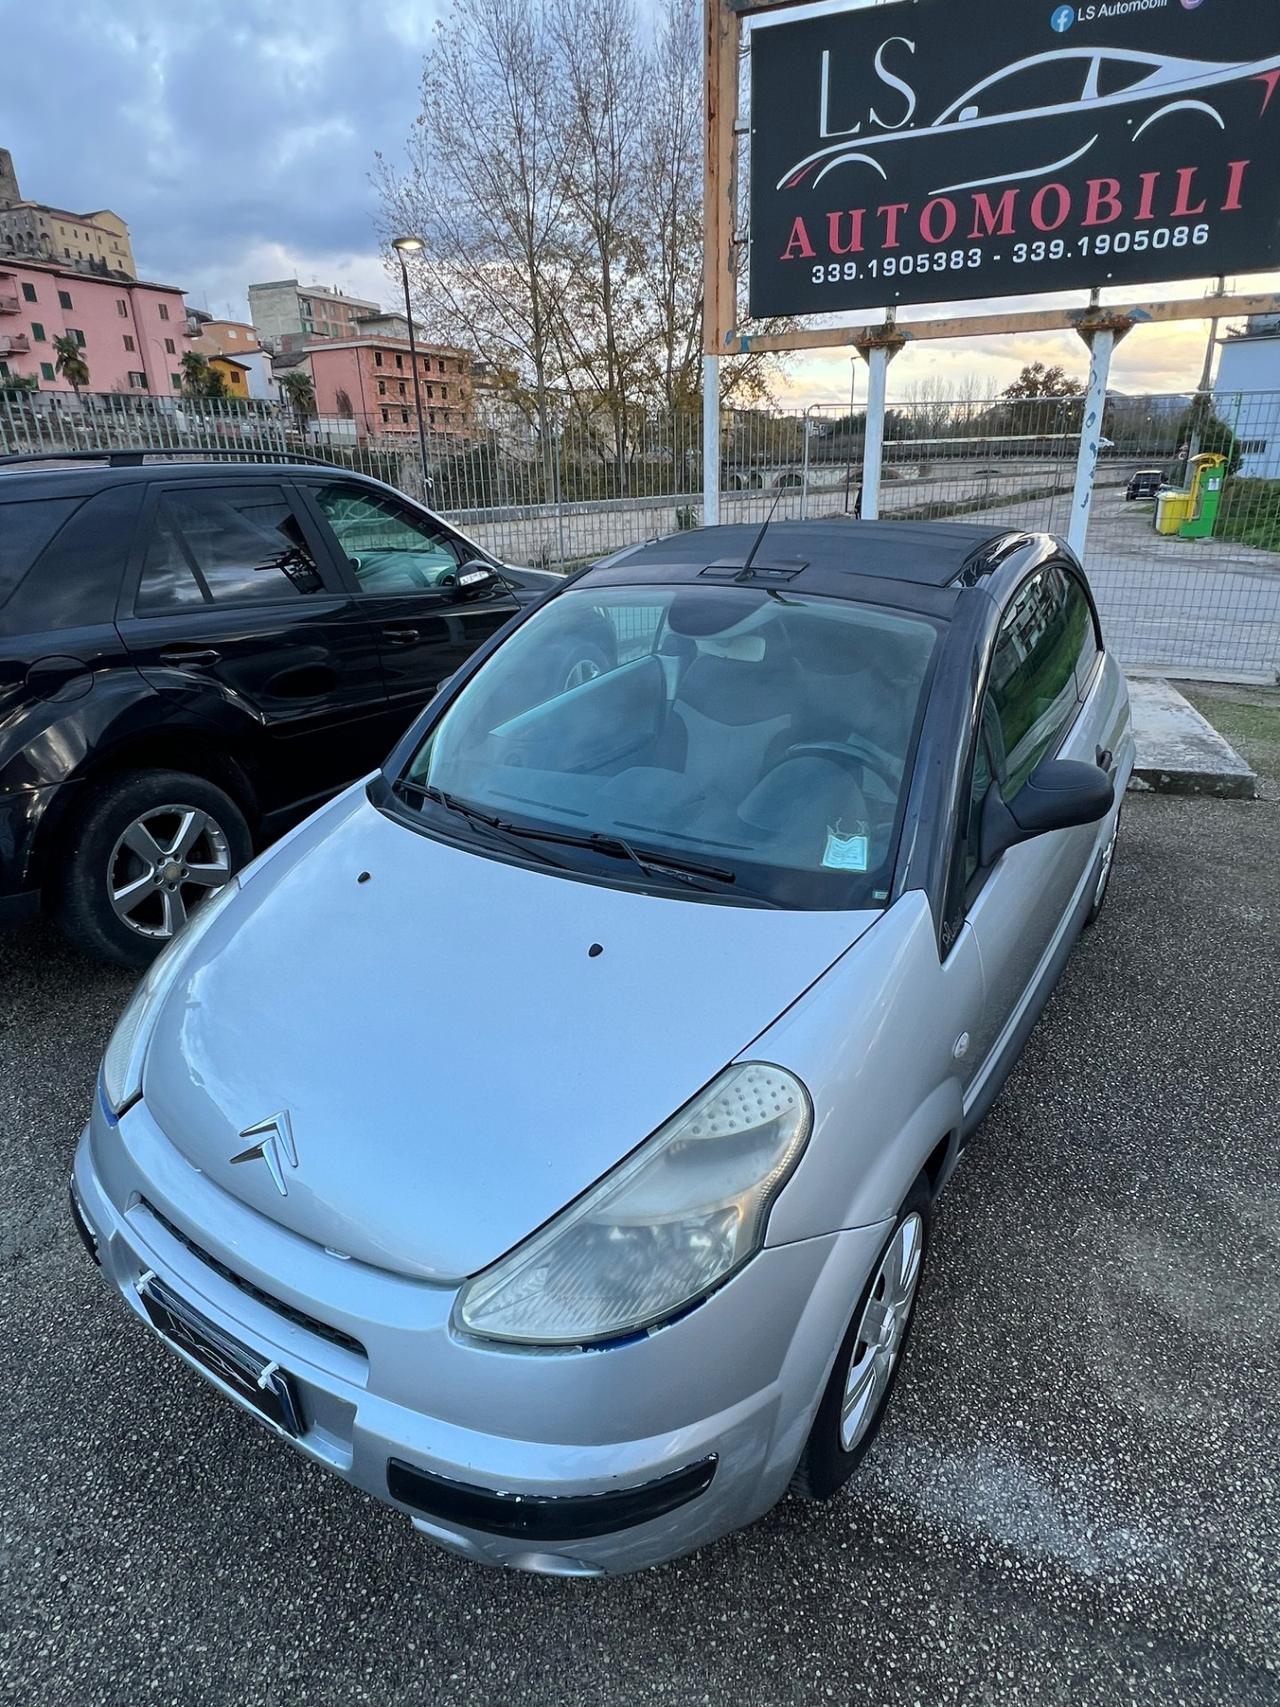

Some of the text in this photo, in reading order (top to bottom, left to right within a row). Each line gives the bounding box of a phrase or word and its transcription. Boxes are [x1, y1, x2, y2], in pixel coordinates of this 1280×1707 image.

[1077, 5, 1095, 22] LS
[780, 159, 1251, 261] AUTOMOBILI
[811, 248, 982, 284] 339.1905383
[1012, 223, 1210, 264] 339.1905086
